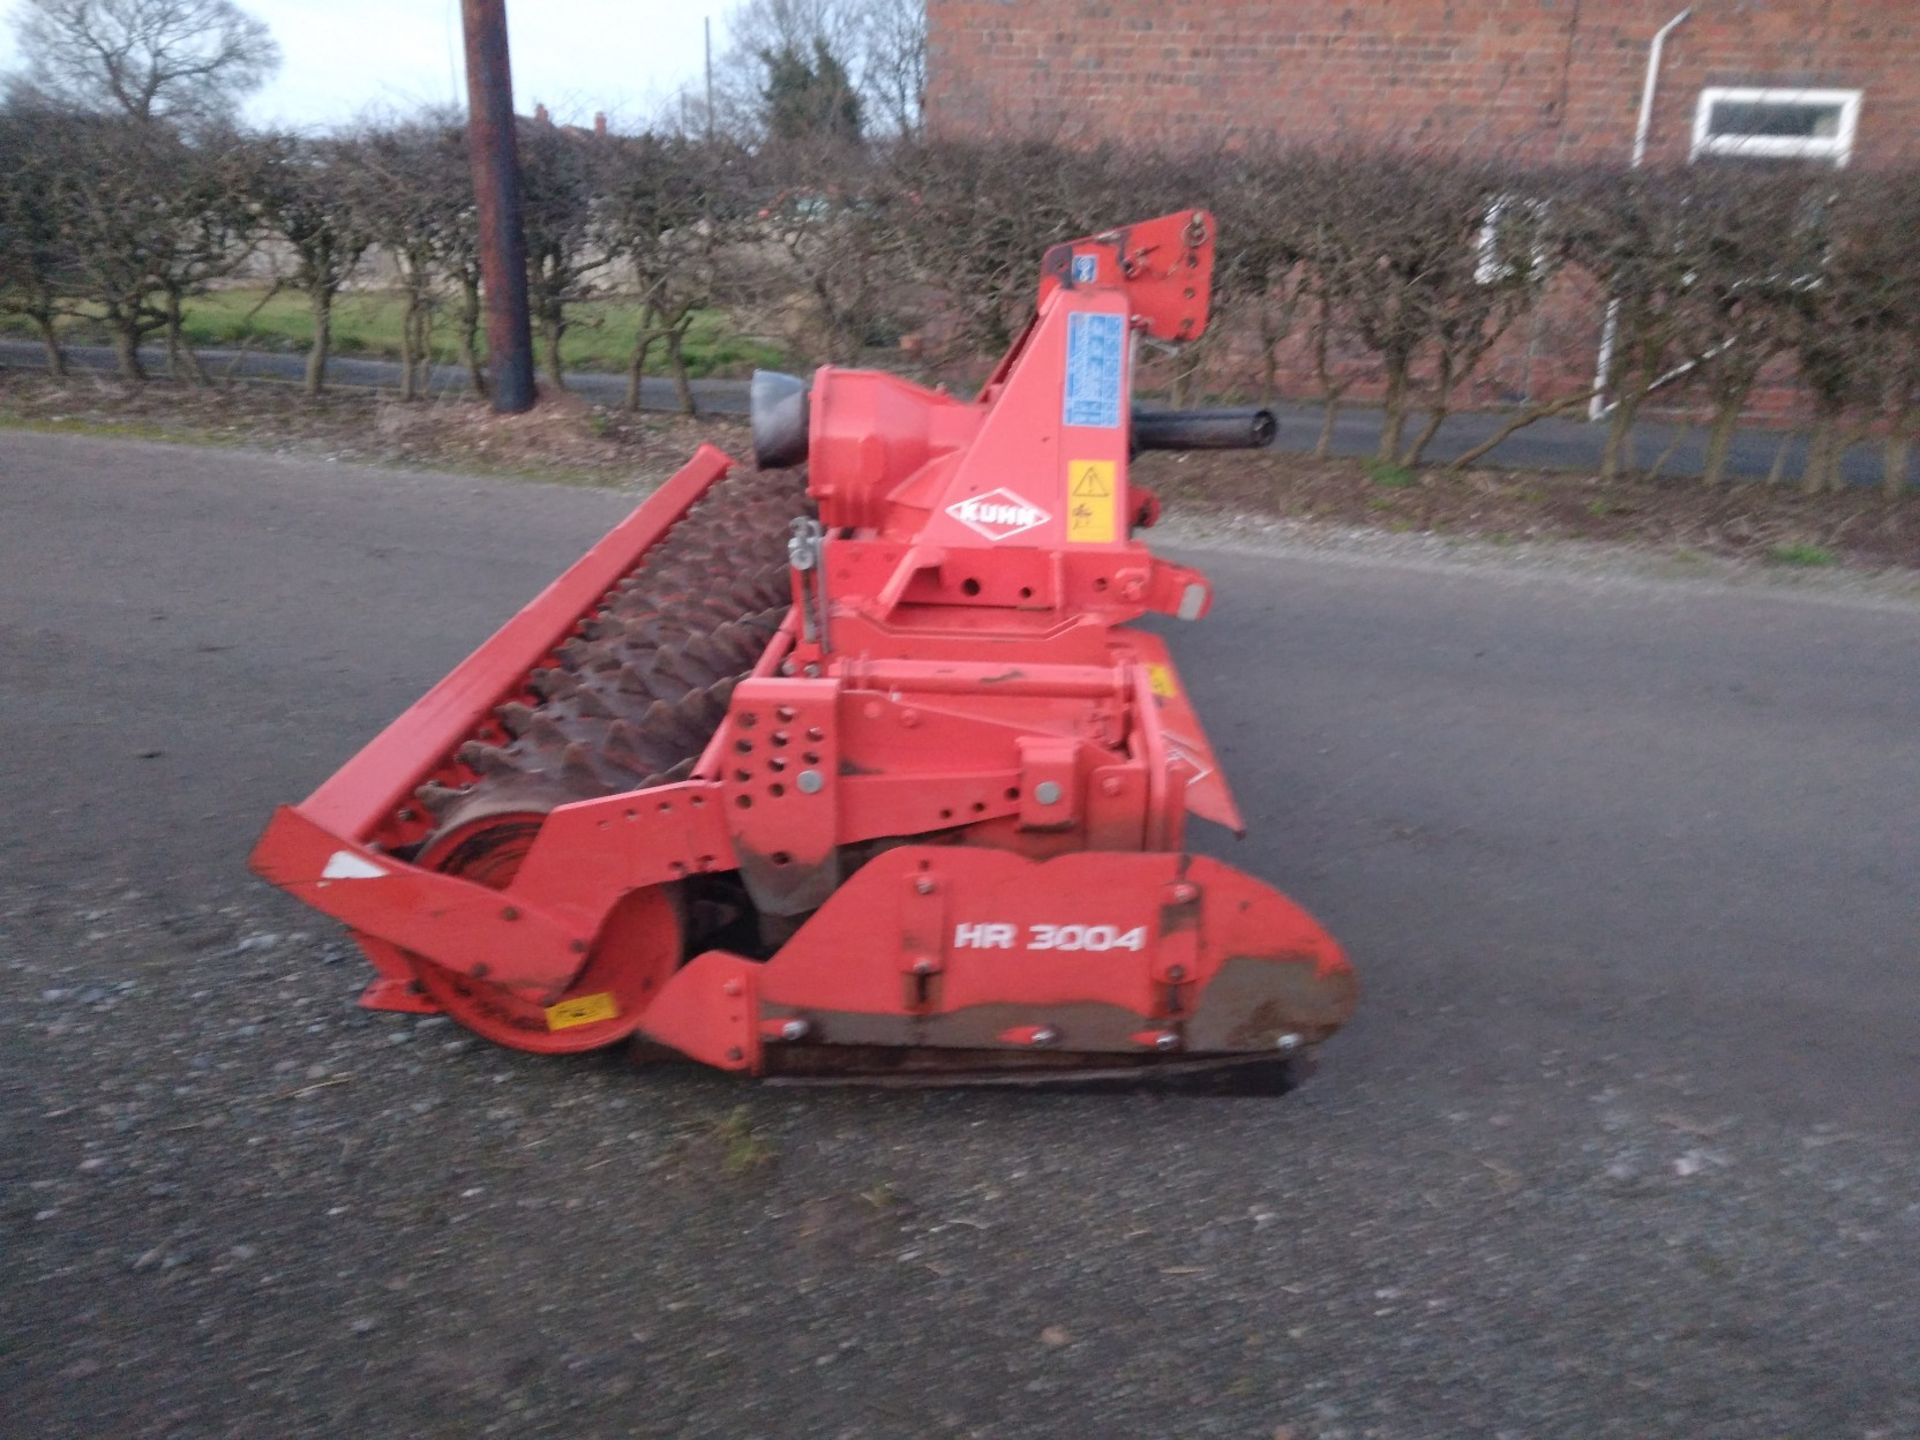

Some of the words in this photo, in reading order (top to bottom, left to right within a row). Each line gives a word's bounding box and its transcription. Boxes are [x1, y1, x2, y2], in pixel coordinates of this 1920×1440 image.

[960, 502, 1036, 526] KUHN
[954, 922, 1016, 949] HR
[1026, 923, 1147, 951] 3004
